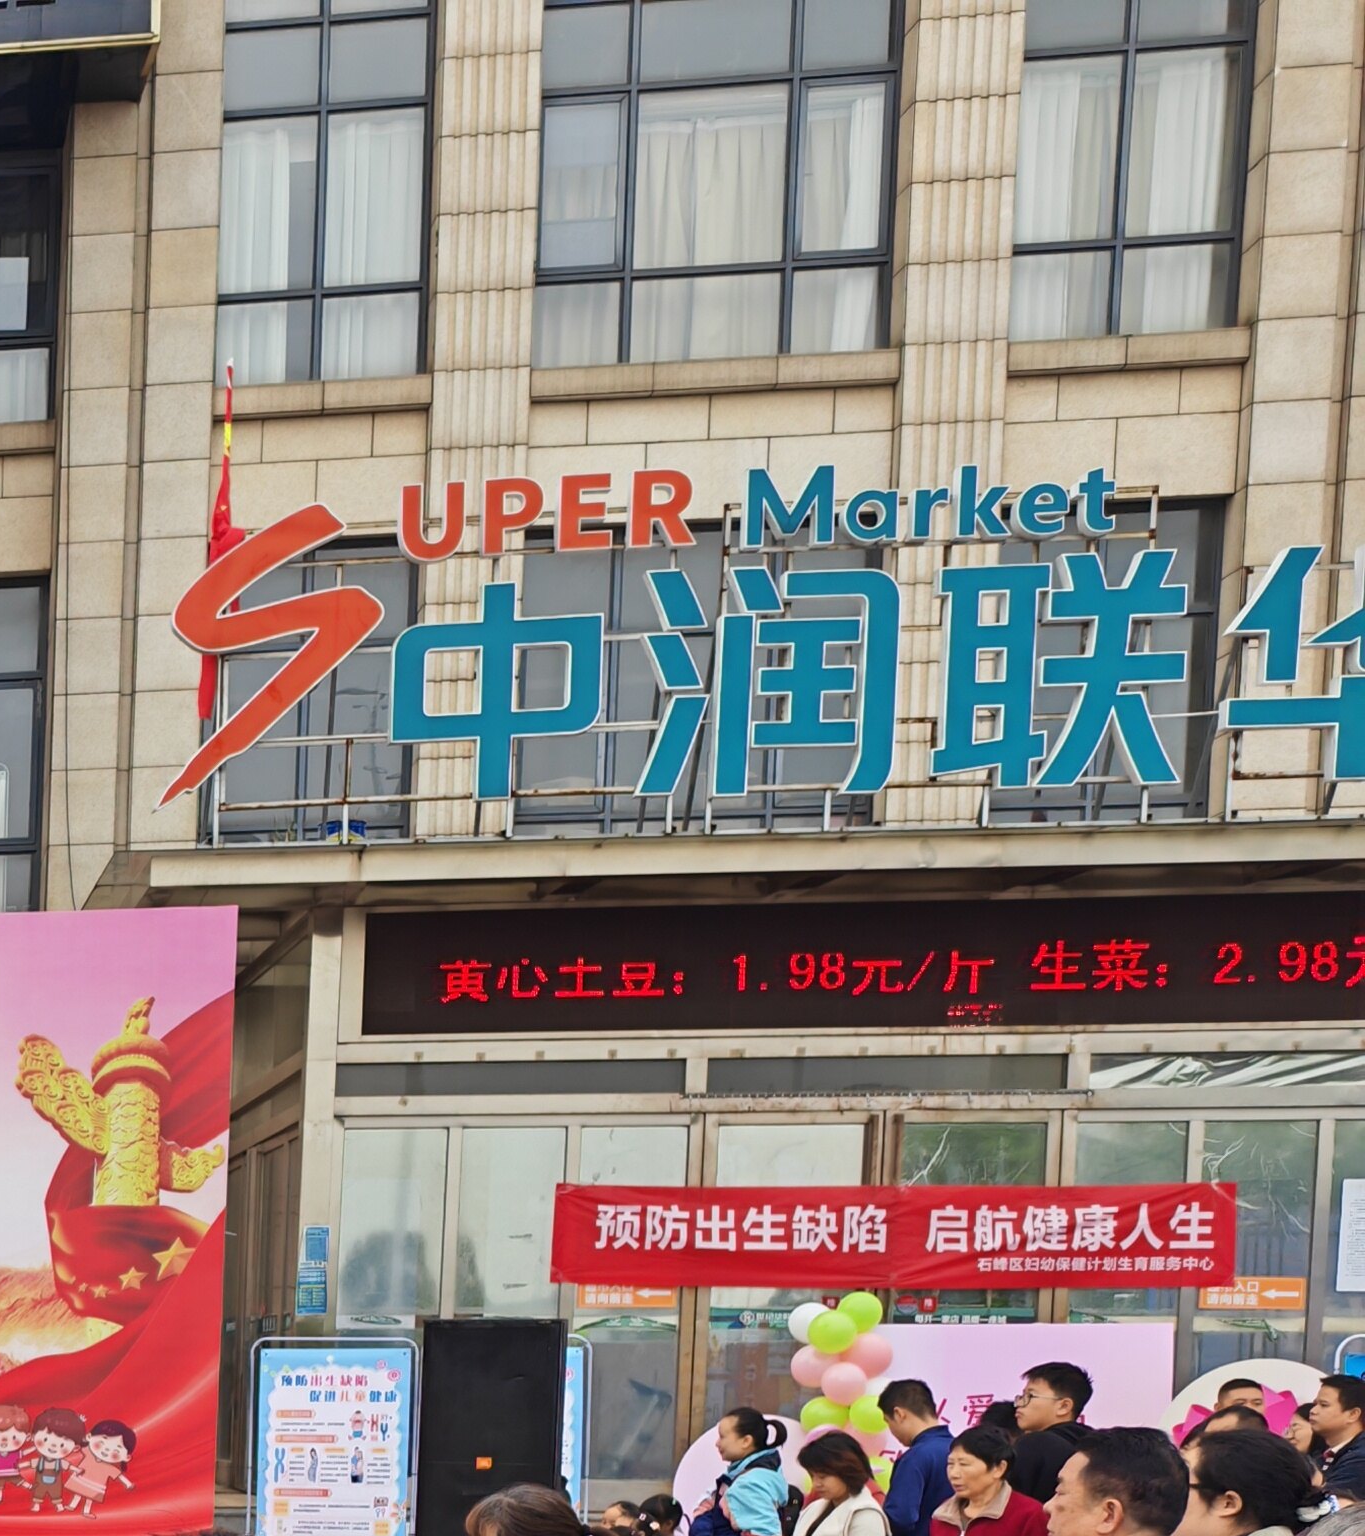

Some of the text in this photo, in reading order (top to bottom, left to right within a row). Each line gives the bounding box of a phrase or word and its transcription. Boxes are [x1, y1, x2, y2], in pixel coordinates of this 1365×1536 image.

[743, 464, 1119, 546] Market
[594, 1202, 1216, 1252] 预防出生缺陷 启航健康人生
[977, 1256, 1215, 1272] 石峰区妇幼保健计划生育服务中心
